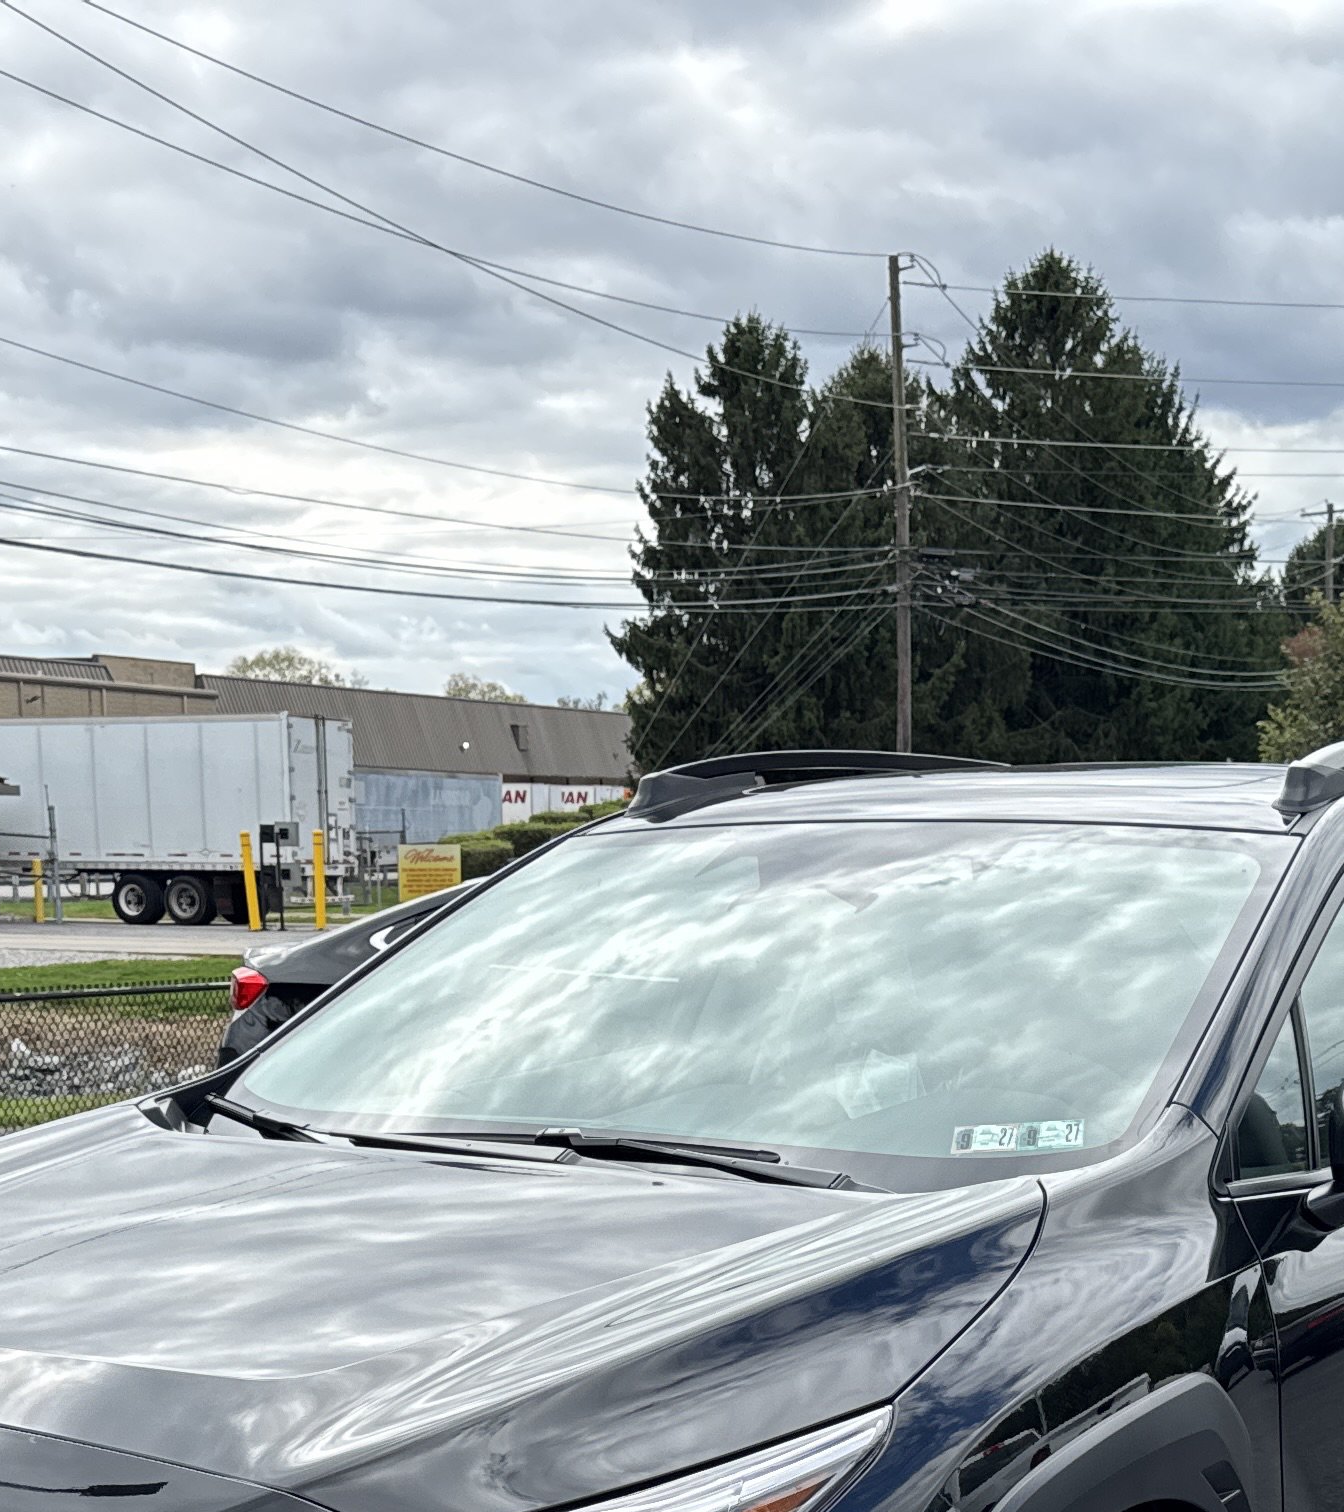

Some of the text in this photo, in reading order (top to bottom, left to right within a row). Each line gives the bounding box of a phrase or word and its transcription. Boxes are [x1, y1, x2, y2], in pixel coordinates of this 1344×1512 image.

[404, 848, 454, 864] Welcome
[960, 1127, 1014, 1150] 9 27
[1026, 1123, 1079, 1146] 9 27
